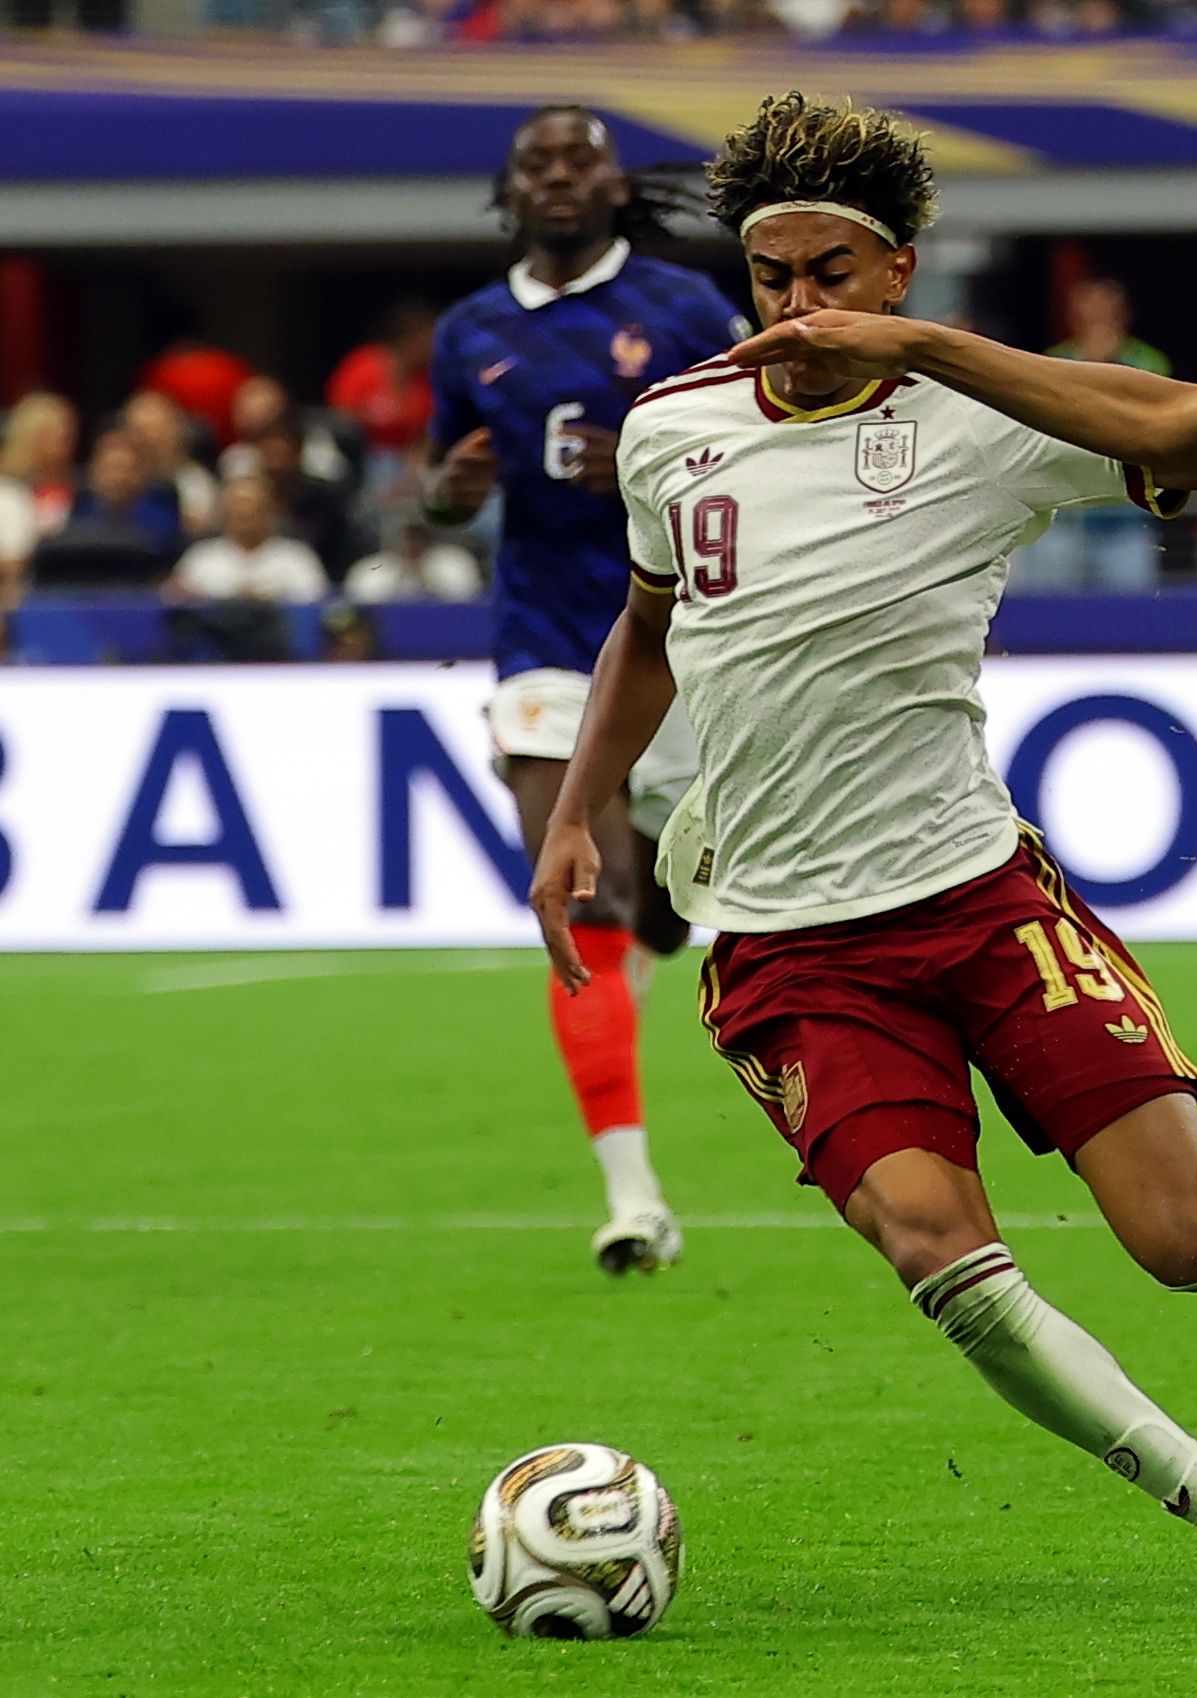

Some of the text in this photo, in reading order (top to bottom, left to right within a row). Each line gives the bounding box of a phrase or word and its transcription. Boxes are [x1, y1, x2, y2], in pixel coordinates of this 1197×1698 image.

[543, 401, 588, 480] 6
[0, 707, 533, 912] AN
[1014, 917, 1126, 1012] 19
